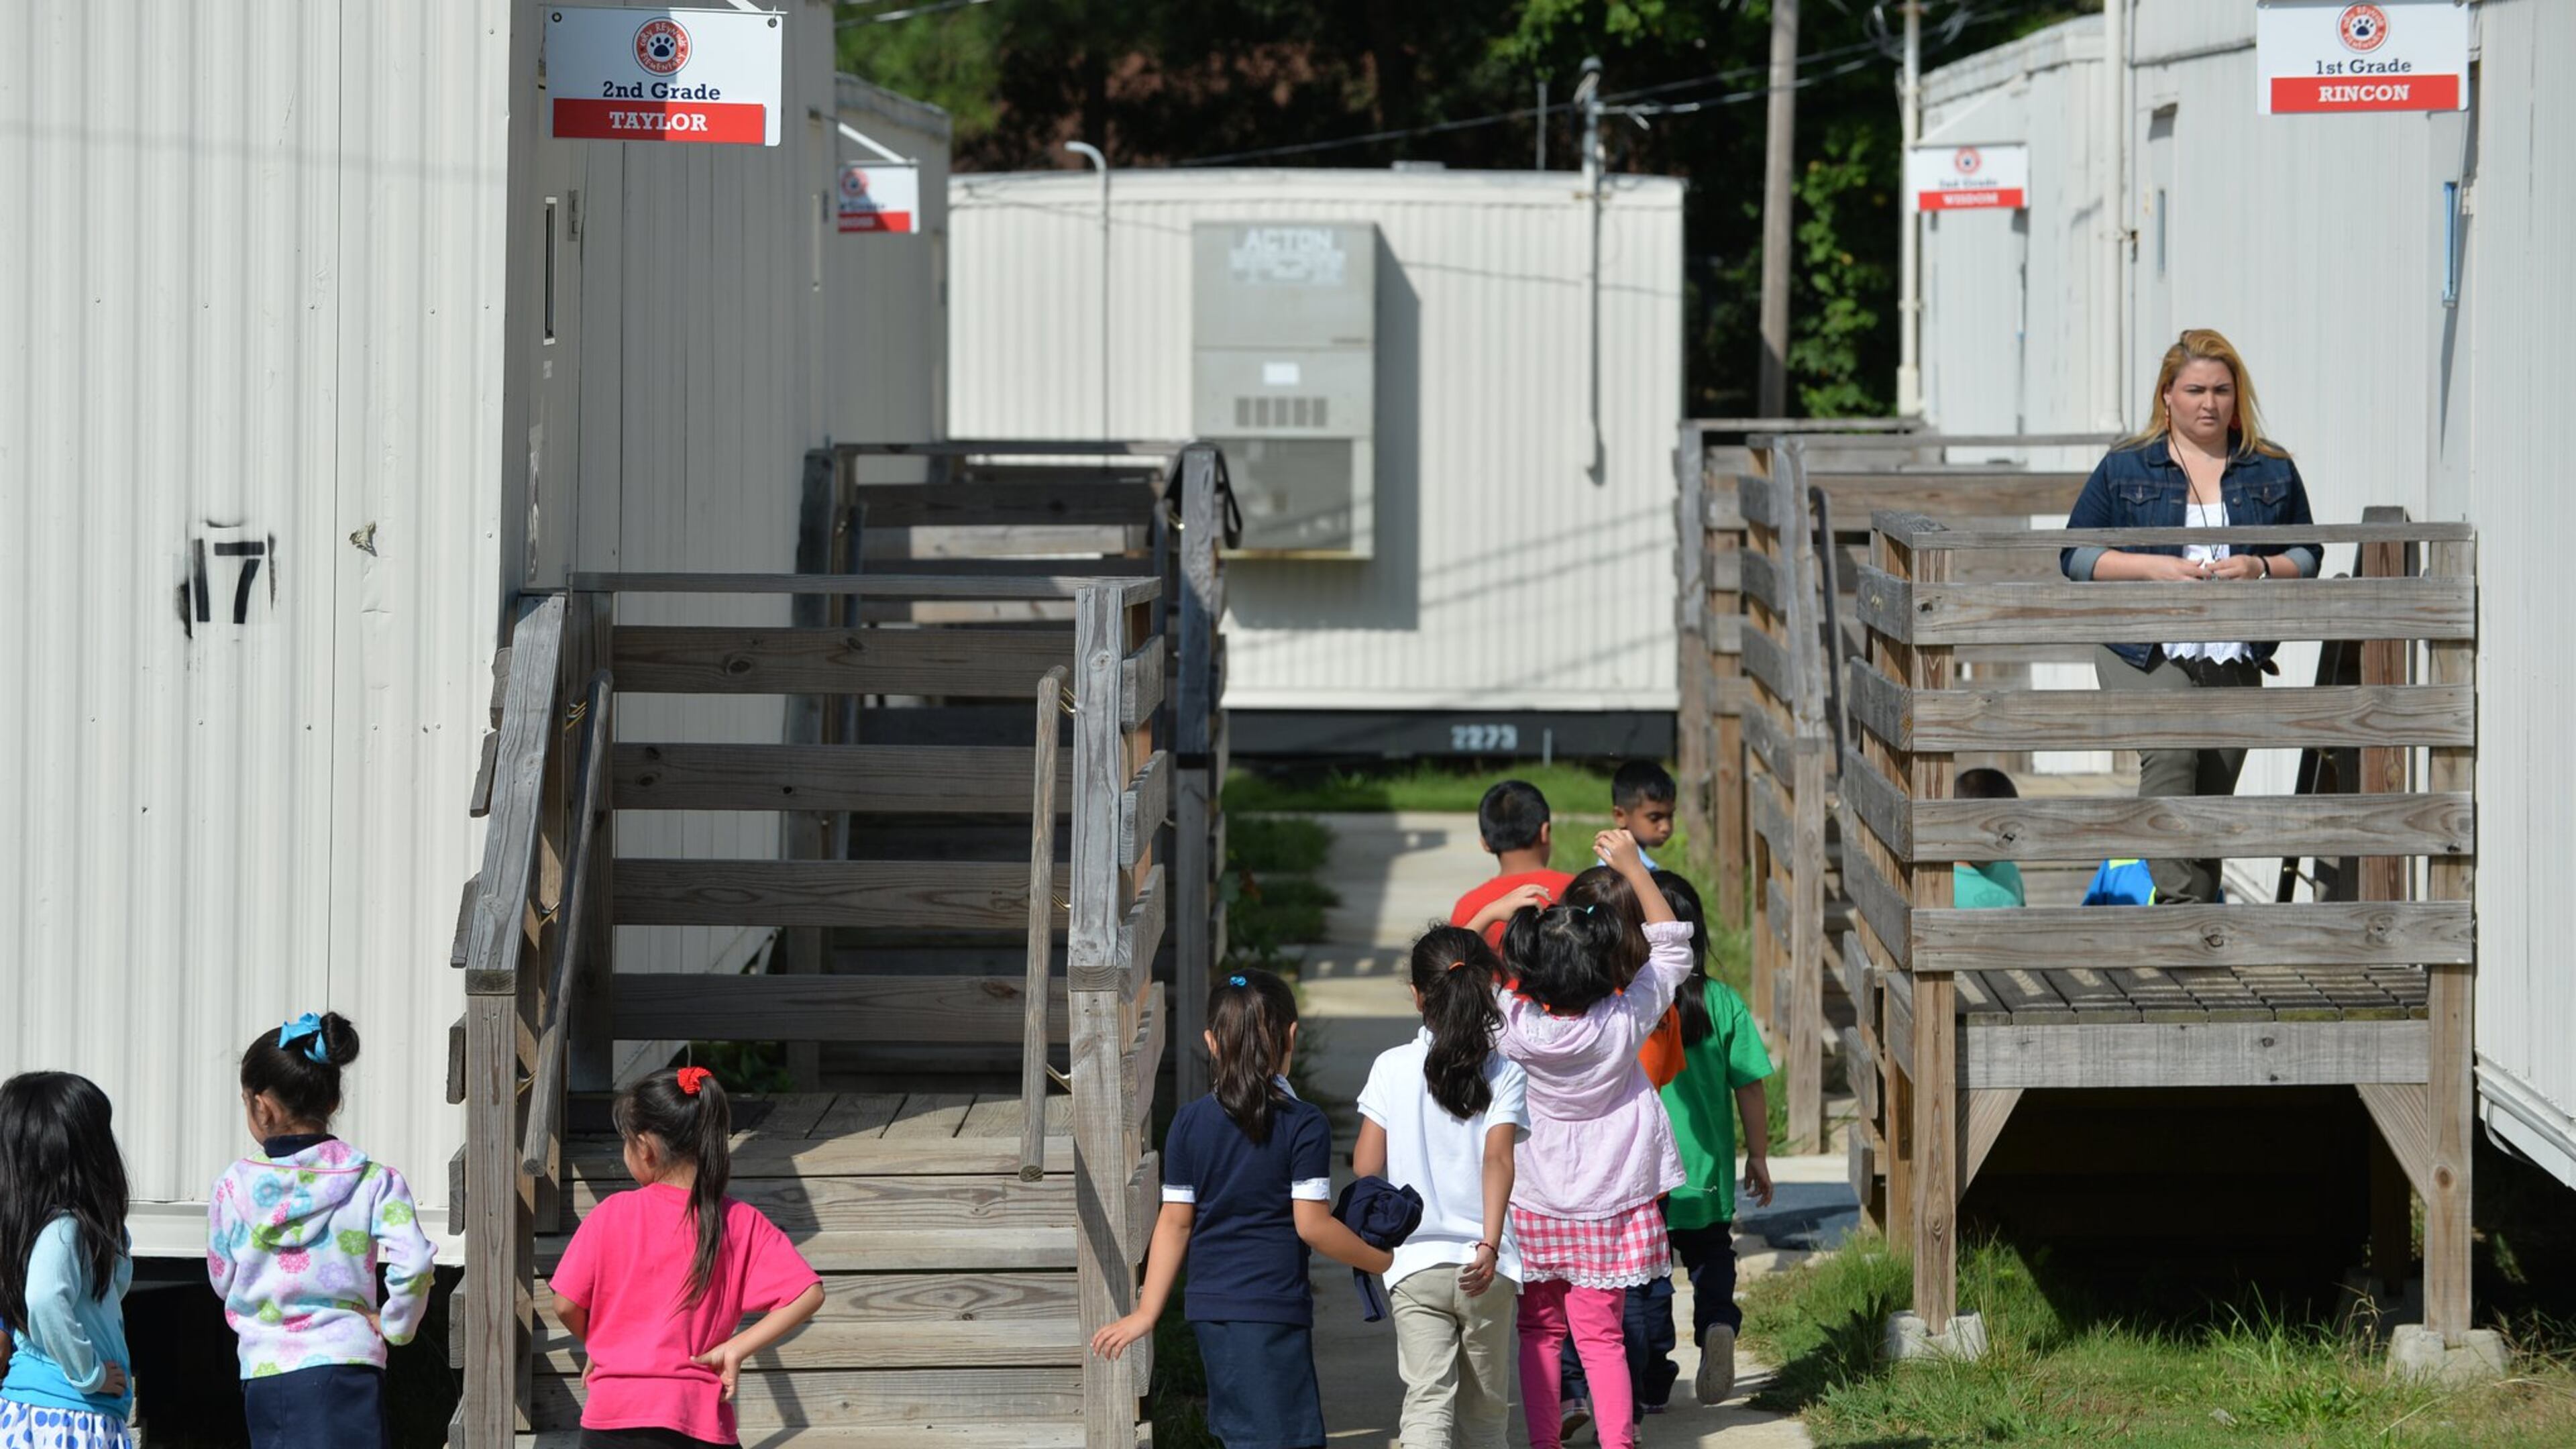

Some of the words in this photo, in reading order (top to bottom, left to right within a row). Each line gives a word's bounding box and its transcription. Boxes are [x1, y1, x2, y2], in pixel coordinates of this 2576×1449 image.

[2316, 60, 2343, 75] 1st
[2350, 58, 2412, 74] Grade
[602, 80, 643, 99] 2nd
[651, 82, 721, 100] Grade
[2318, 85, 2410, 103] RINCON
[609, 111, 708, 131] TAYLOR
[1244, 228, 1333, 250] ACTON
[193, 537, 266, 624] 17
[1451, 724, 1517, 751] 2273
